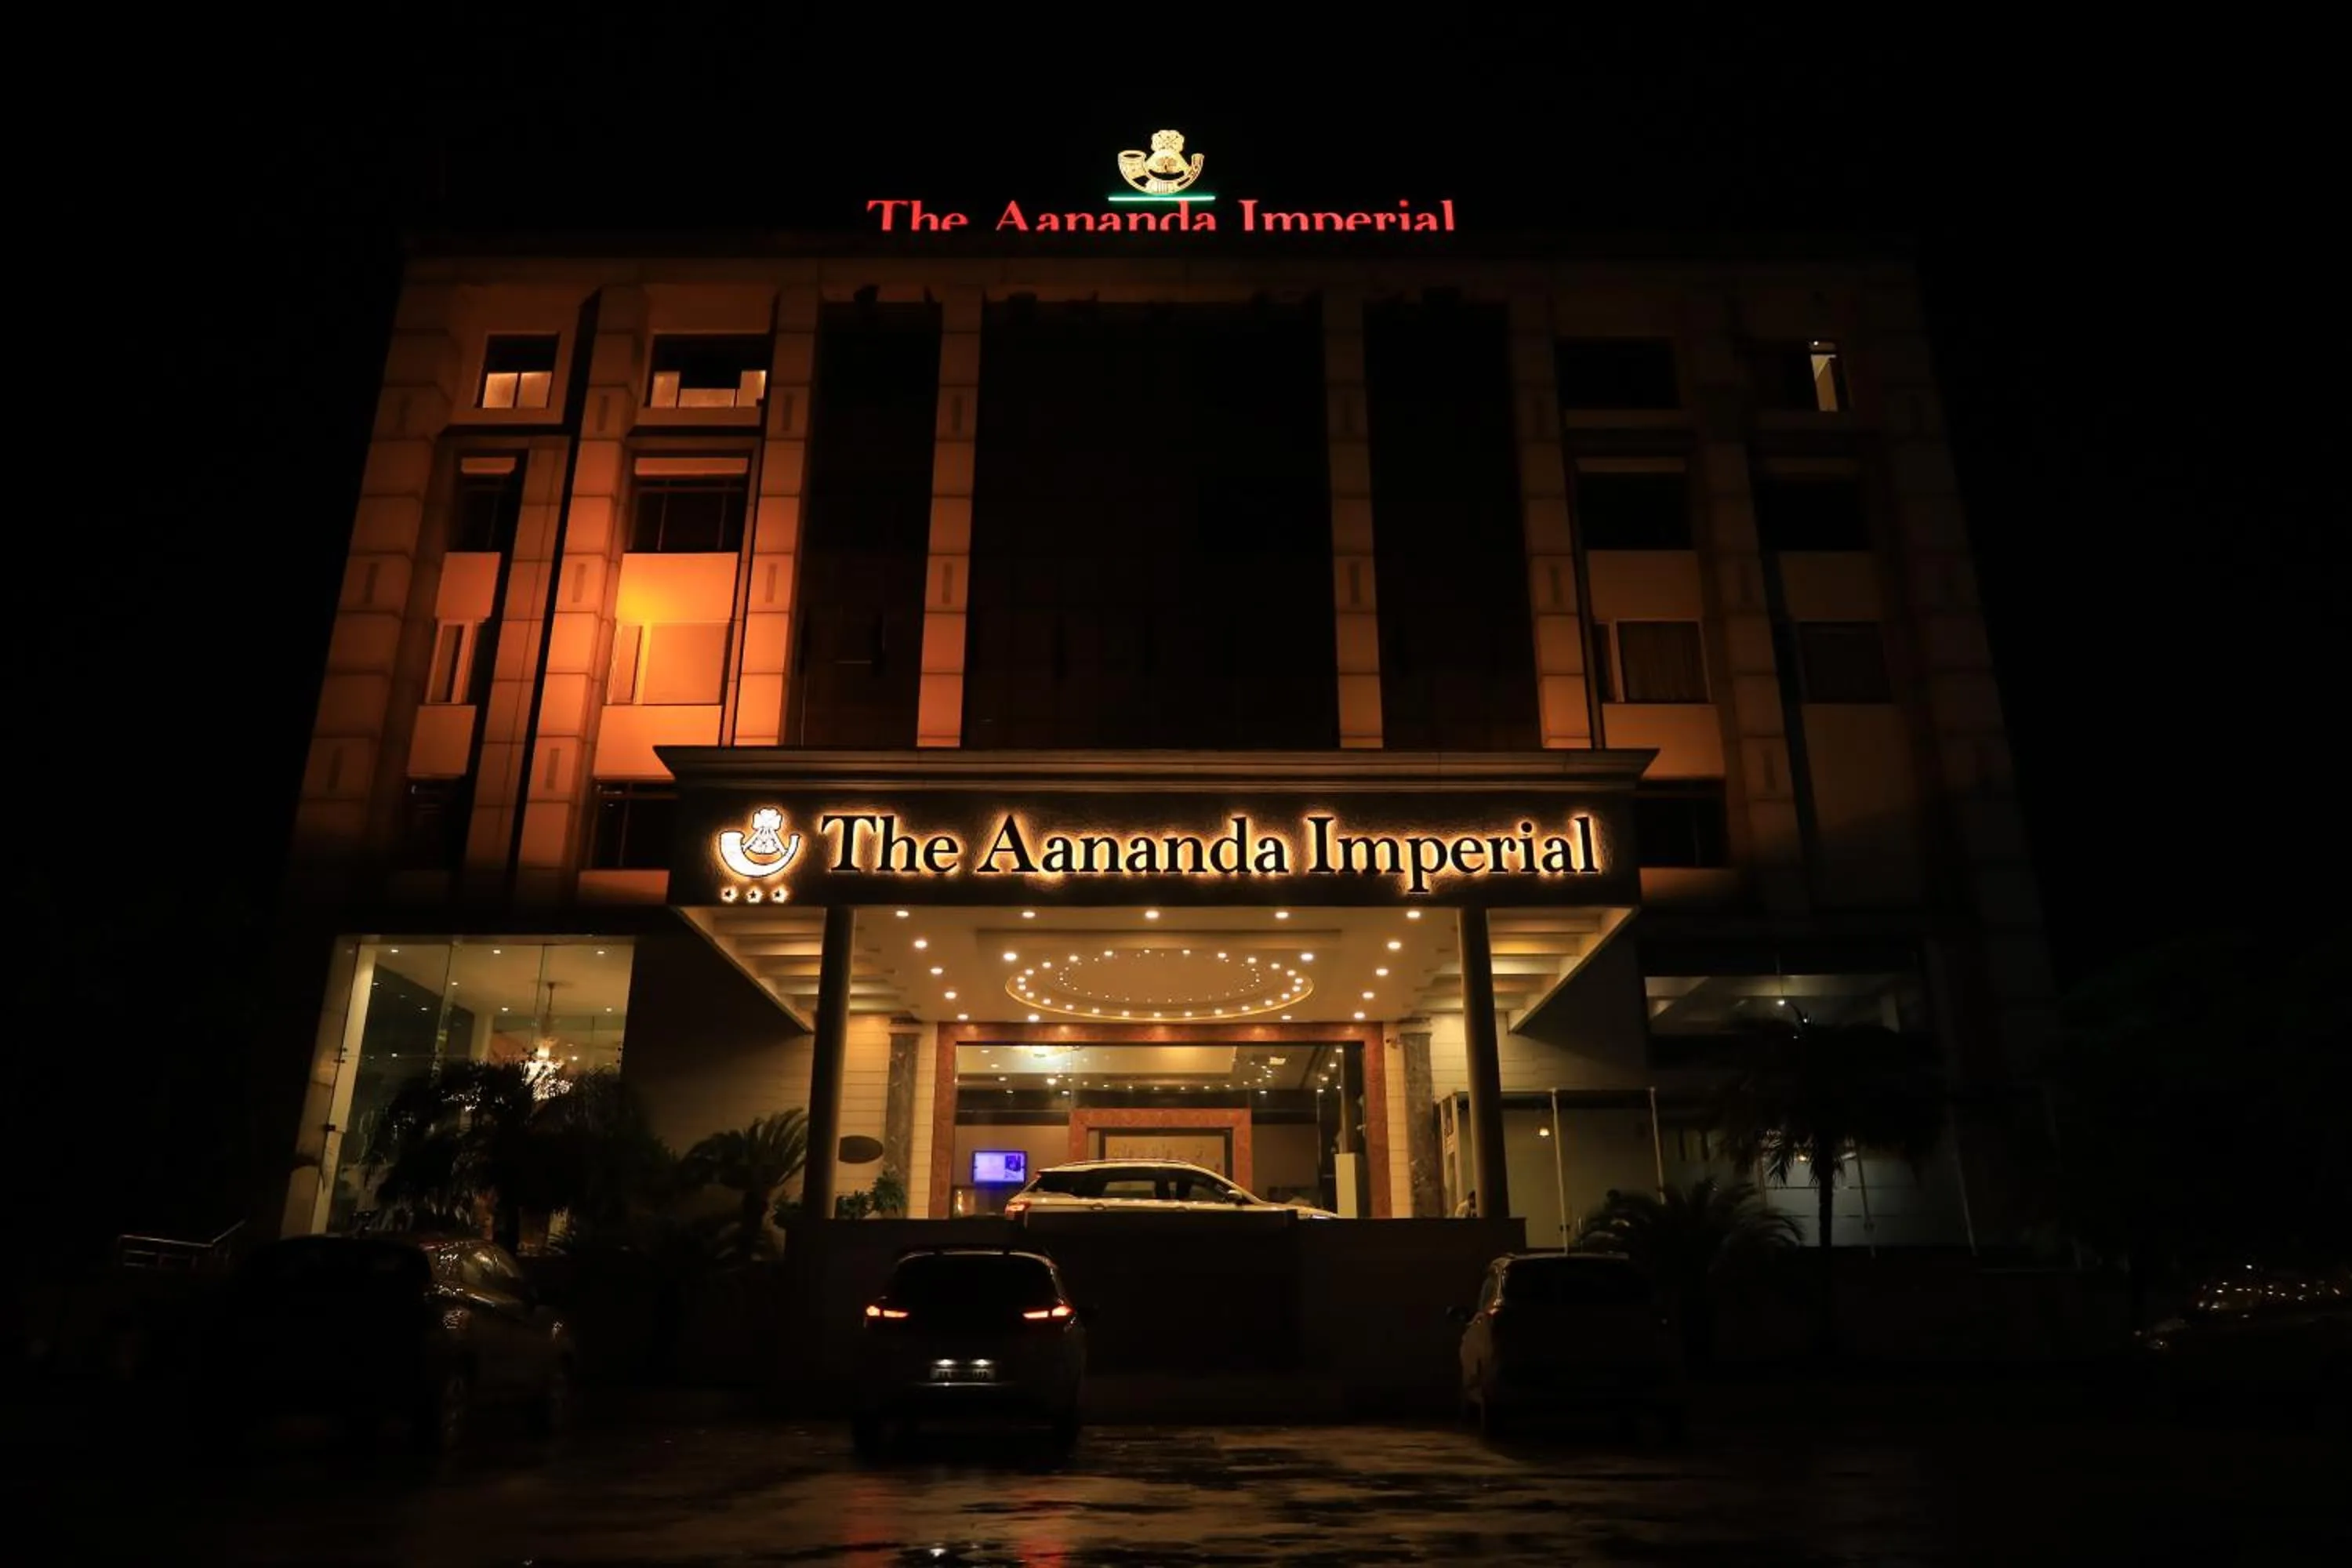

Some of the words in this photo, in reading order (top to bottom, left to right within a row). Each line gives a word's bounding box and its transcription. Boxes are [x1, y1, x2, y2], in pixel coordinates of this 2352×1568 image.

[866, 199, 969, 231] The
[995, 199, 1217, 231] Aananda
[821, 814, 959, 873] The
[977, 814, 1289, 873] Aananda
[1307, 815, 1599, 893] Imperial
